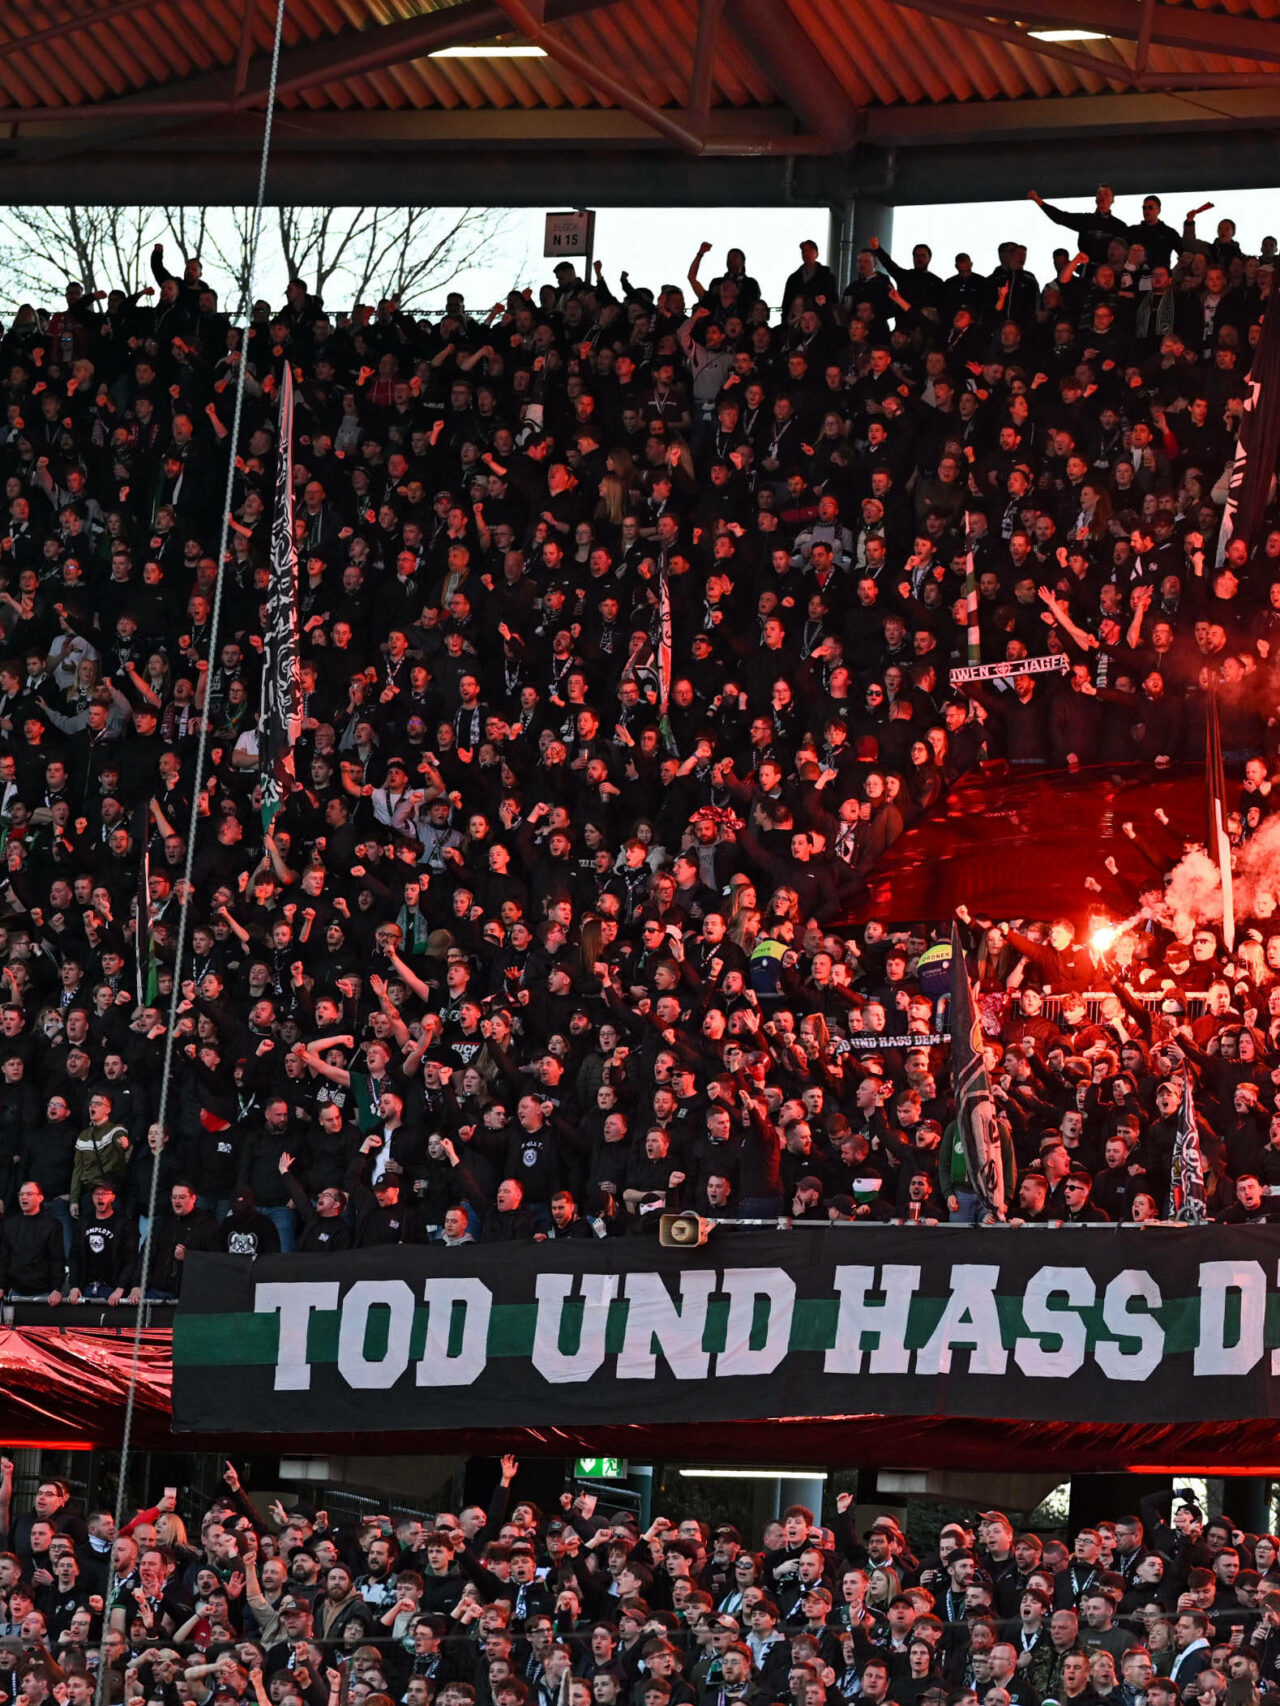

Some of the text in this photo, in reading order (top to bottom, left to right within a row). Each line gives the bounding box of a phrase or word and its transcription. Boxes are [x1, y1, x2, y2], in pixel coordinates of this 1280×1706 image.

[553, 233, 578, 246] N 15
[850, 1037, 877, 1049] UND
[878, 1035, 912, 1048] HASS
[914, 1033, 940, 1046] DEM
[253, 1277, 493, 1391] TOD
[531, 1267, 797, 1384] UND
[823, 1264, 1166, 1382] HASS
